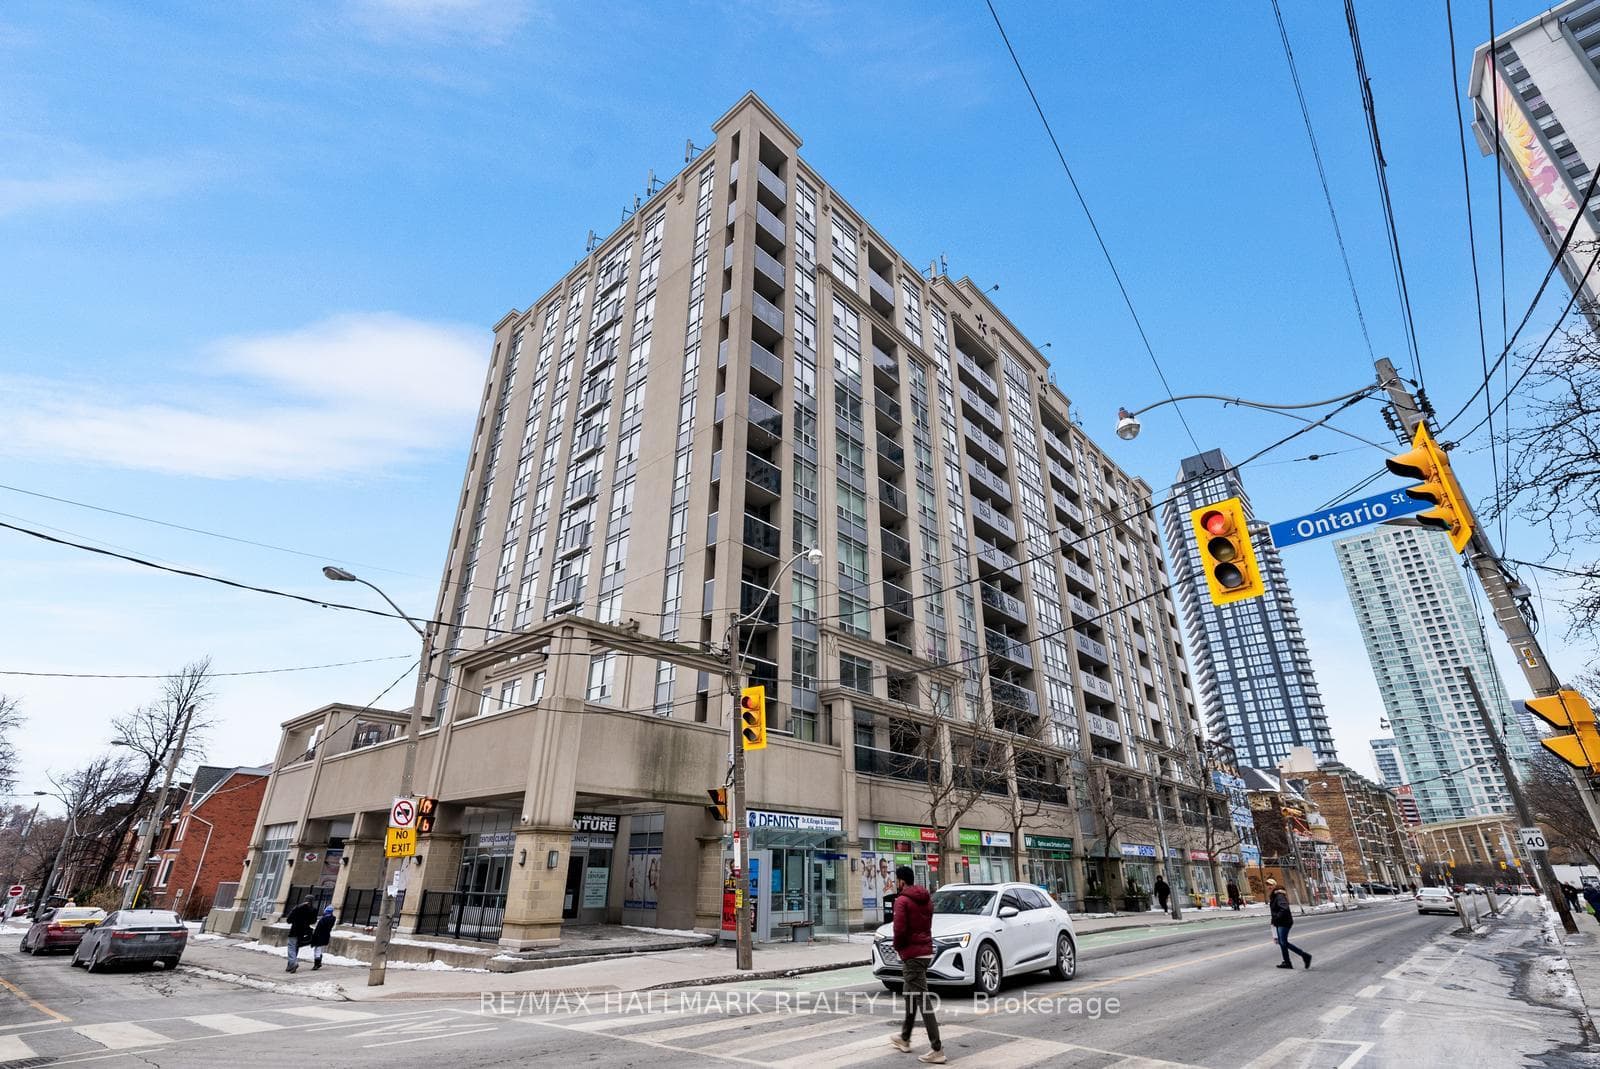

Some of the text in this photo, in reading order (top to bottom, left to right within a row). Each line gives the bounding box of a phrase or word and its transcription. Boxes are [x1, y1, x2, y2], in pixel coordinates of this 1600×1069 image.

[1297, 493, 1405, 538] Ontario St
[572, 819, 616, 831] NTURE
[760, 813, 799, 828] DENTIST
[396, 831, 408, 839] NO
[1527, 836, 1545, 847] 40
[391, 843, 411, 853] EXIT
